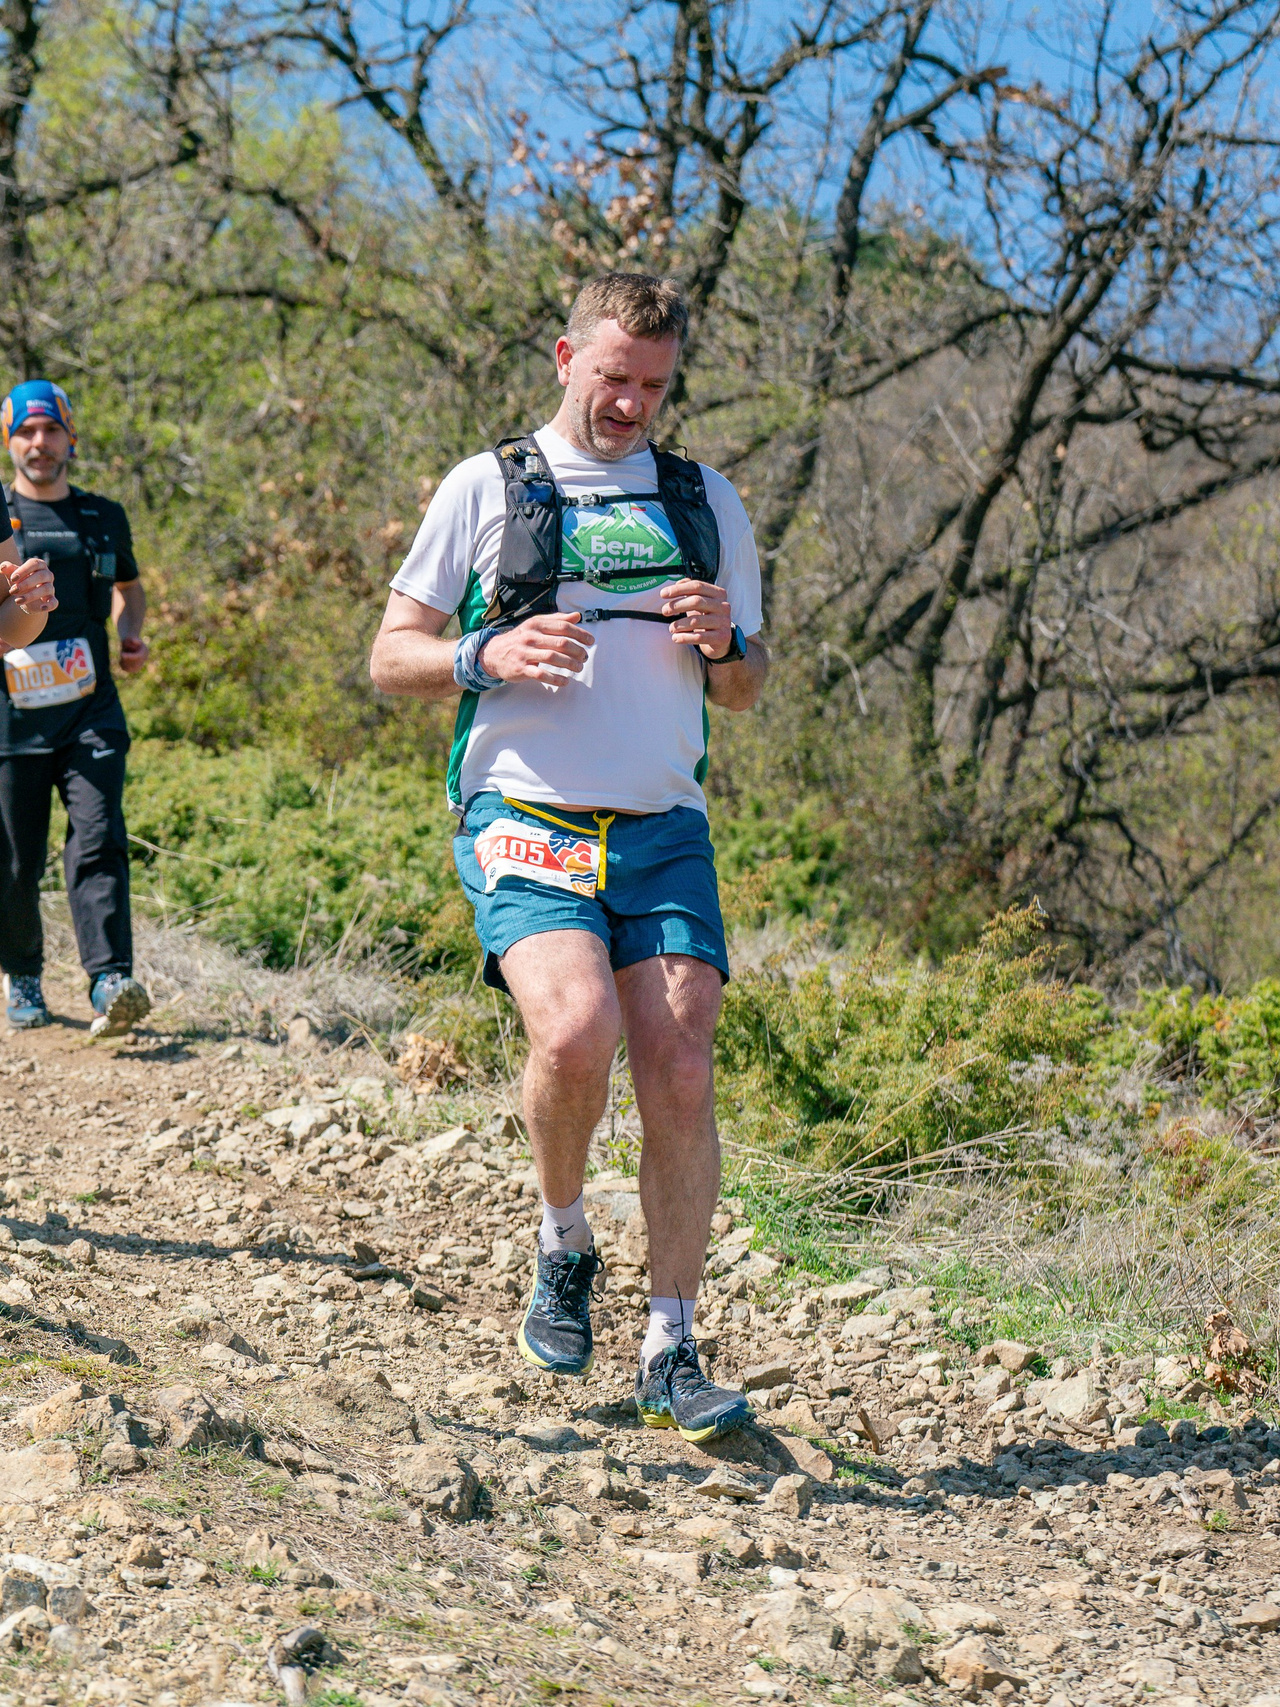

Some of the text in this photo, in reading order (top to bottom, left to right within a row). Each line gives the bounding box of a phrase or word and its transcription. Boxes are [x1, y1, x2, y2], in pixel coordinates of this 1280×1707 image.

[591, 535, 654, 559] Бели
[13, 664, 55, 692] 1108
[477, 837, 545, 869] 2405
